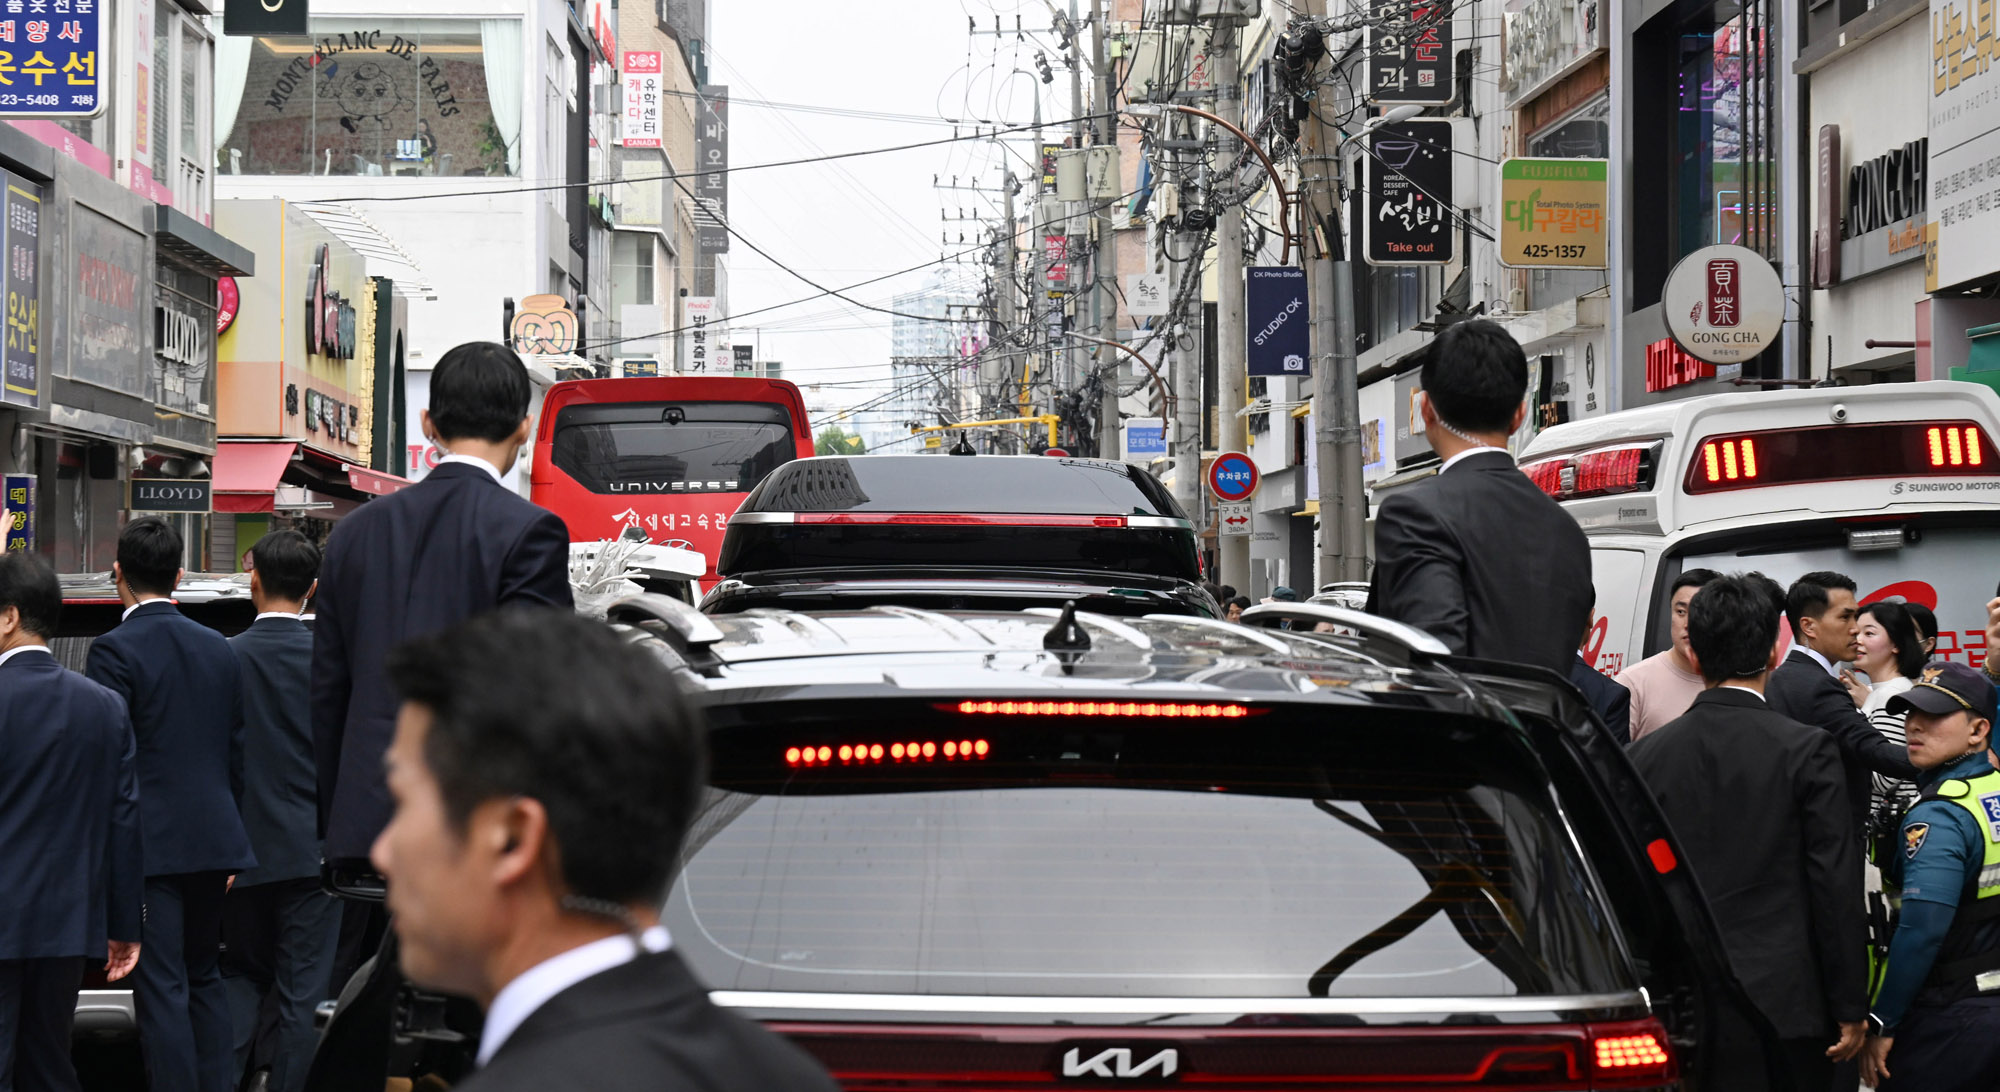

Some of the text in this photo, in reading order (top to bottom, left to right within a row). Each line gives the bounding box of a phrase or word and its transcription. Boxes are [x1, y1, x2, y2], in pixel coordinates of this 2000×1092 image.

[0, 20, 83, 43] 대양사
[629, 54, 657, 68] SOS
[265, 29, 461, 117] MONT BLANC DE PARIS
[1419, 73, 1433, 82] 3F
[0, 94, 59, 105] 23-5408
[71, 94, 94, 106] 지하
[629, 79, 641, 120] 캐나다
[644, 79, 656, 134] 유학센터
[1522, 166, 1588, 177] FUJIFILM
[1899, 137, 1928, 219] CH
[1505, 187, 1603, 234] 대구칼라
[1575, 201, 1600, 209] System
[1379, 192, 1443, 233] 설빙
[1386, 242, 1434, 252] Take out
[1523, 245, 1586, 258] 425-1357
[1710, 262, 1734, 325] 貢茶
[1254, 297, 1303, 346] STUDIO CK
[163, 306, 200, 366] LLOYD
[1692, 331, 1760, 343] GONG CHA
[1218, 472, 1250, 480] 주차금지
[610, 481, 738, 491] UNIVERSE
[1909, 482, 2000, 492] SUNGWOO MOTOR
[139, 487, 203, 499] LLOYD
[1934, 630, 1988, 668] 구급
